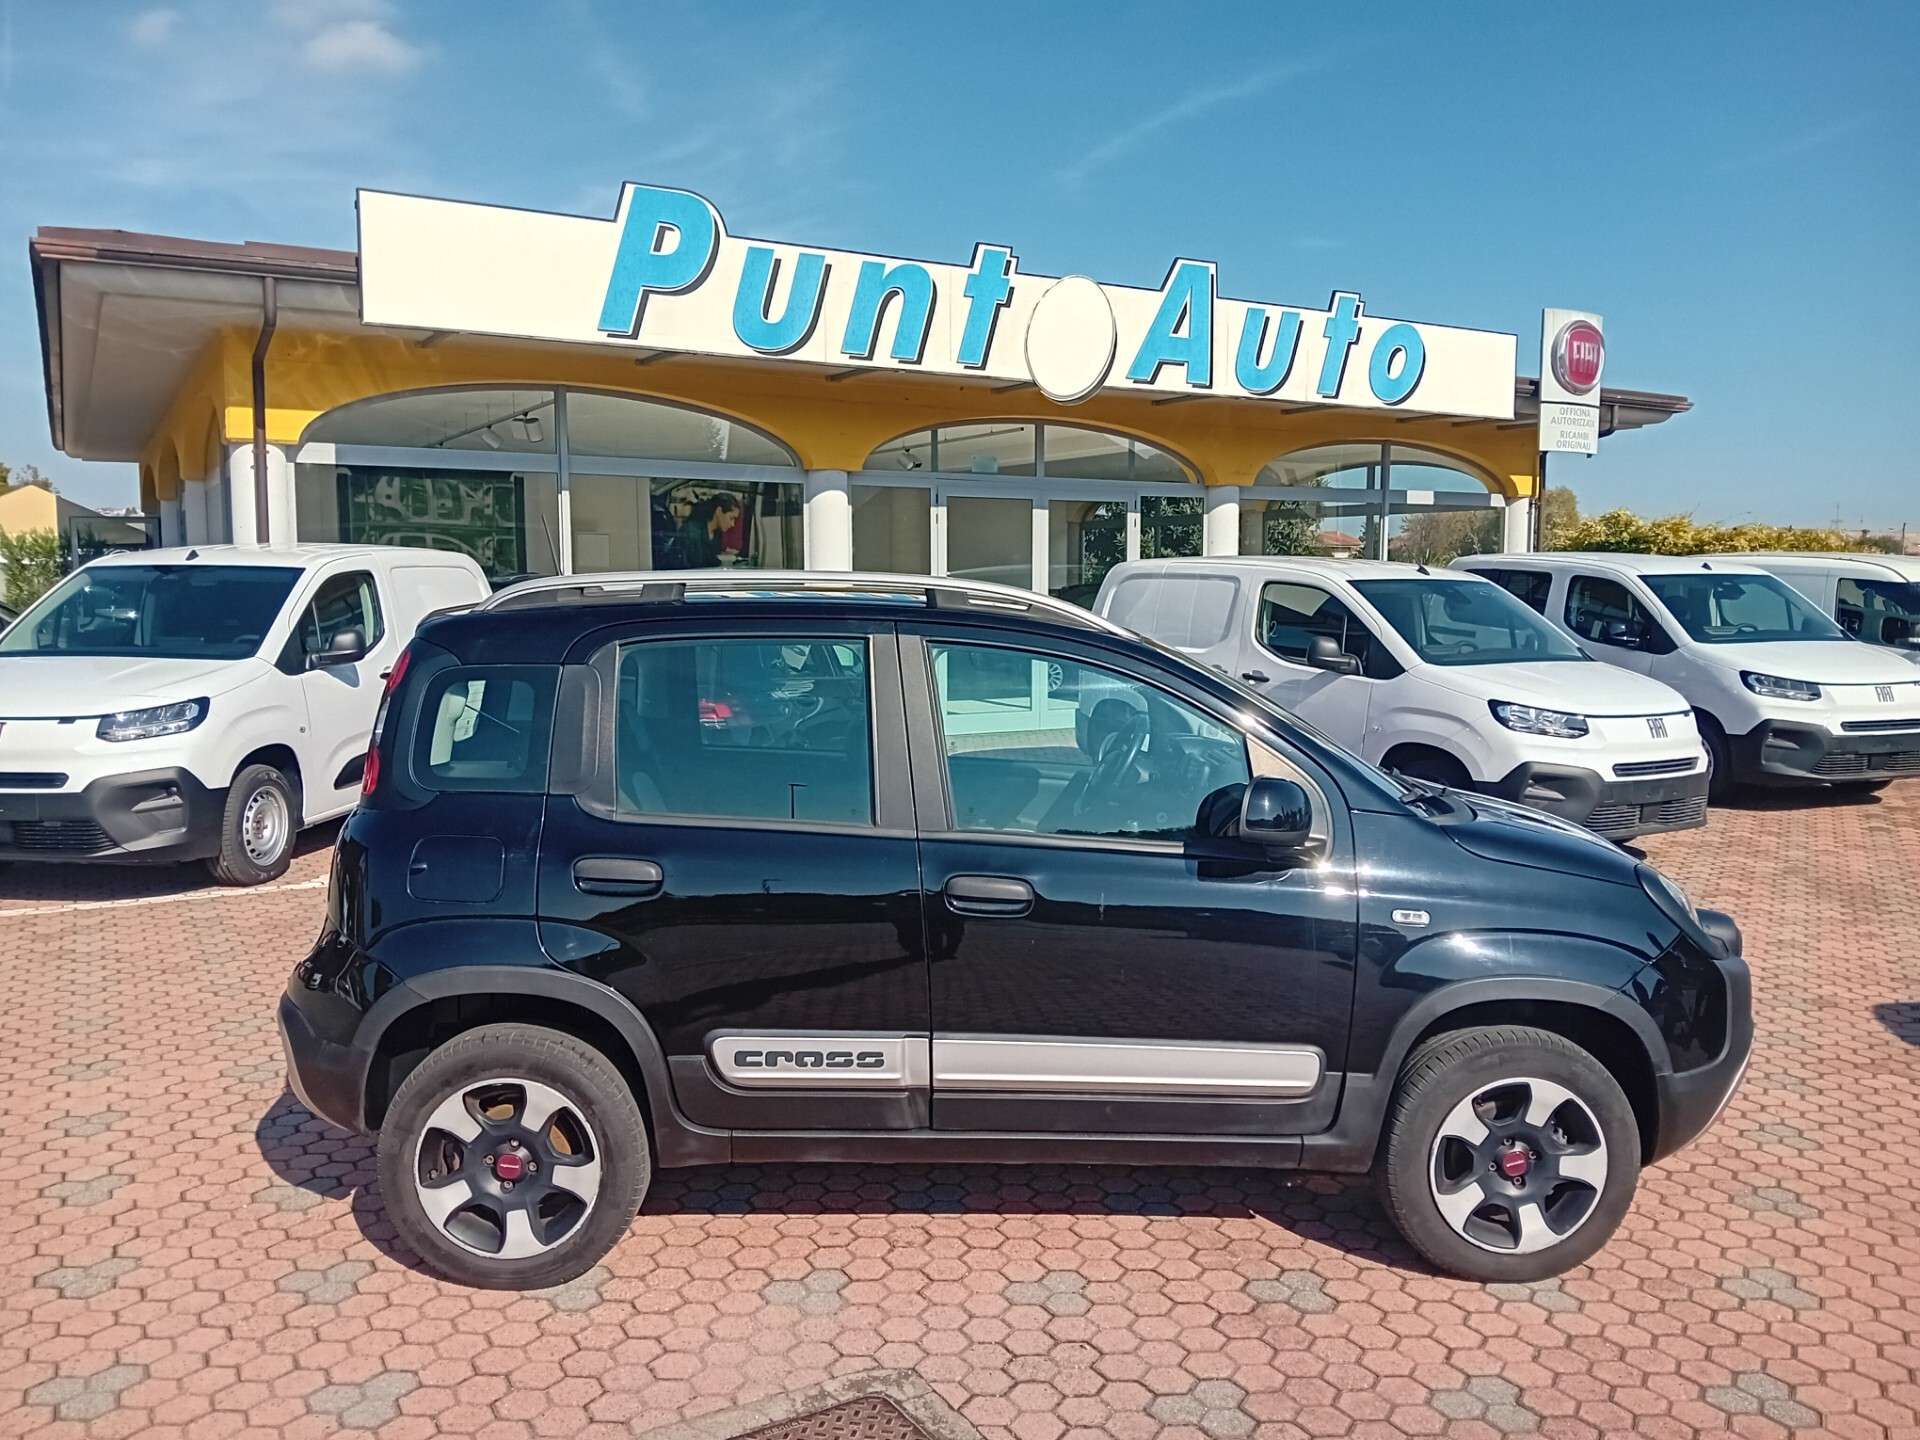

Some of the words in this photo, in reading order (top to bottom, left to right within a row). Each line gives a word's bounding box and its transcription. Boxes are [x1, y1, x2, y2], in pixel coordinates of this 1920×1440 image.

[1126, 261, 1427, 406] Auto
[1573, 340, 1599, 362] FIAT
[1559, 407, 1591, 418] OFFICINA
[1874, 685, 1895, 703] FIAT
[1646, 717, 1669, 739] FIAT
